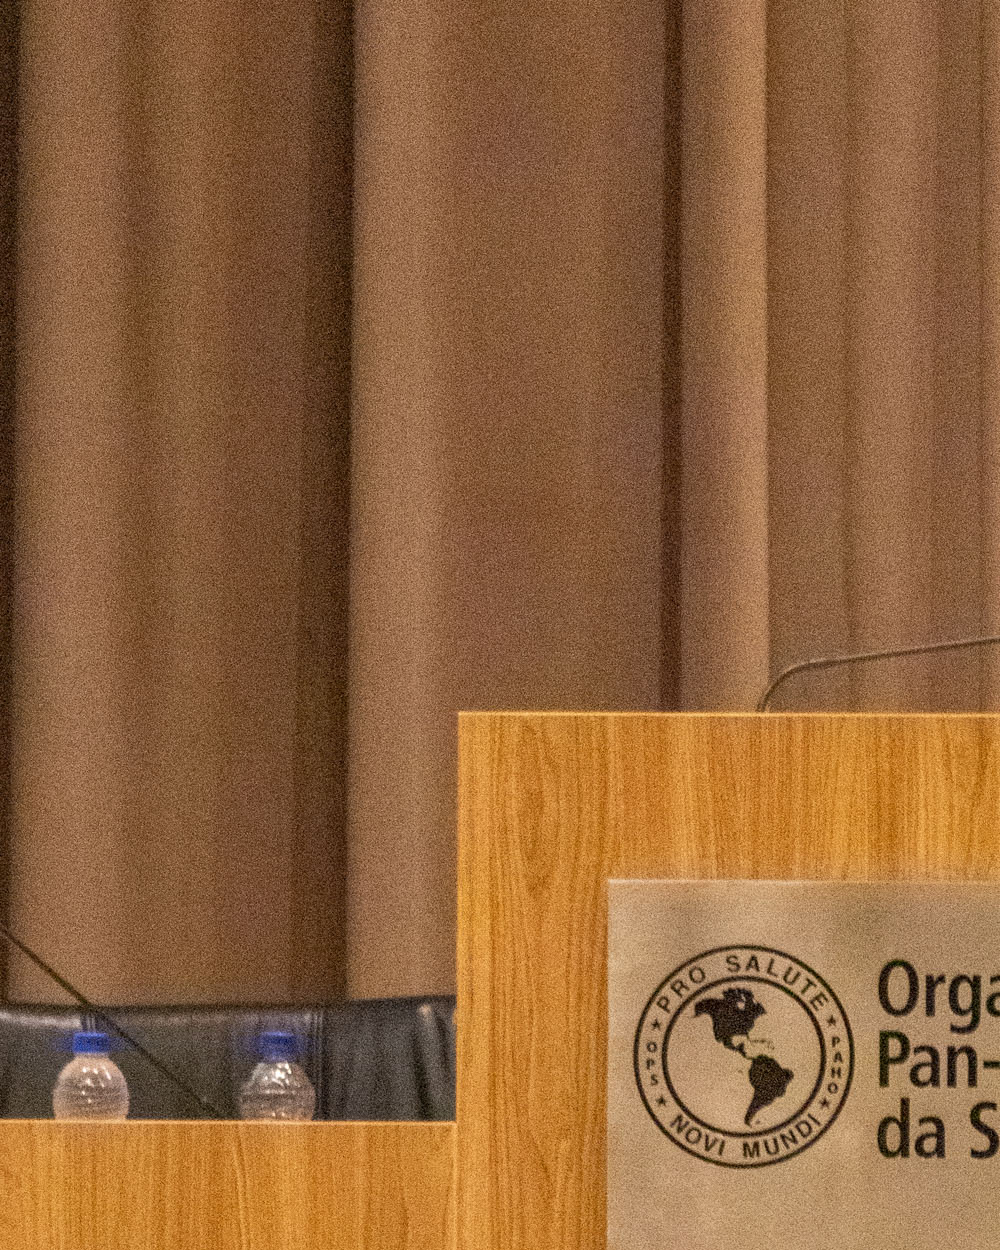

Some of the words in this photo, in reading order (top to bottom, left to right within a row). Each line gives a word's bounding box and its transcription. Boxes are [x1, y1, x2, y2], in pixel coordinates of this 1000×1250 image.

[656, 965, 707, 1014] PRO
[725, 954, 830, 1012] SALUTE
[645, 1040, 659, 1087] OPS
[827, 1036, 844, 1095] PAHO
[669, 1114, 726, 1156] NOVI
[742, 1113, 821, 1159] MUNDI
[877, 1097, 946, 1159] da
